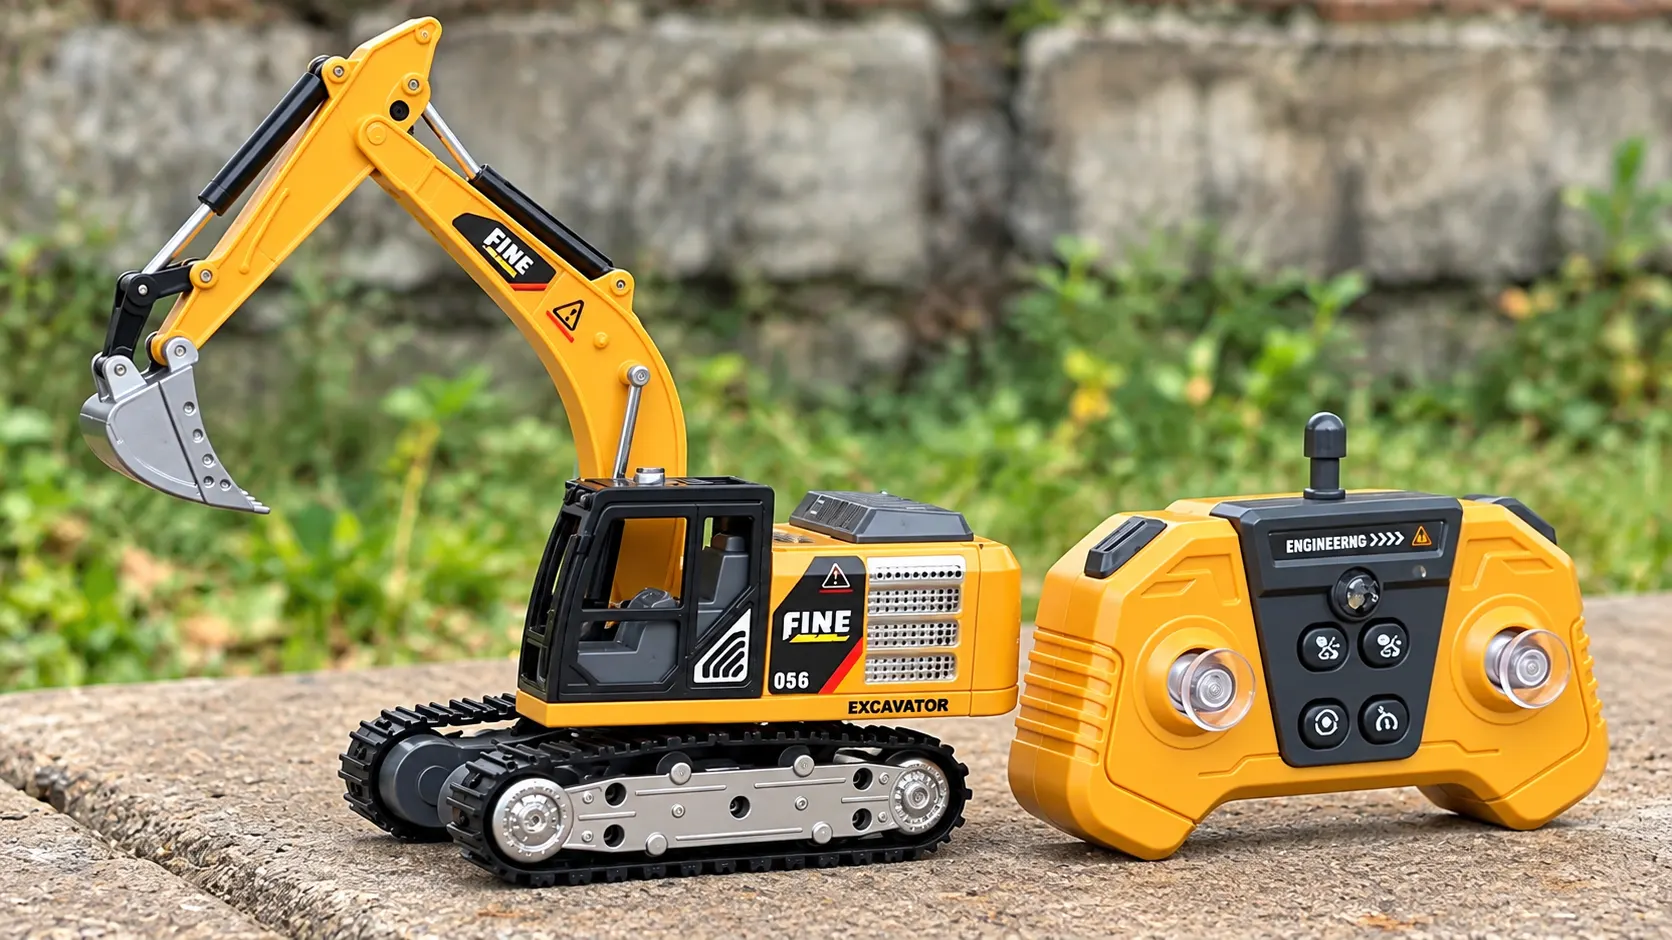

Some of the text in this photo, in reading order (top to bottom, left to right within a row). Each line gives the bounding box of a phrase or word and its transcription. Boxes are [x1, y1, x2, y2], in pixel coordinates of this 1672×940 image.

[483, 227, 534, 276] FINE
[1286, 534, 1367, 553] ENGINEERNG
[782, 609, 852, 640] FINE
[773, 671, 809, 690] 056
[848, 698, 949, 715] EXCAVATOR
